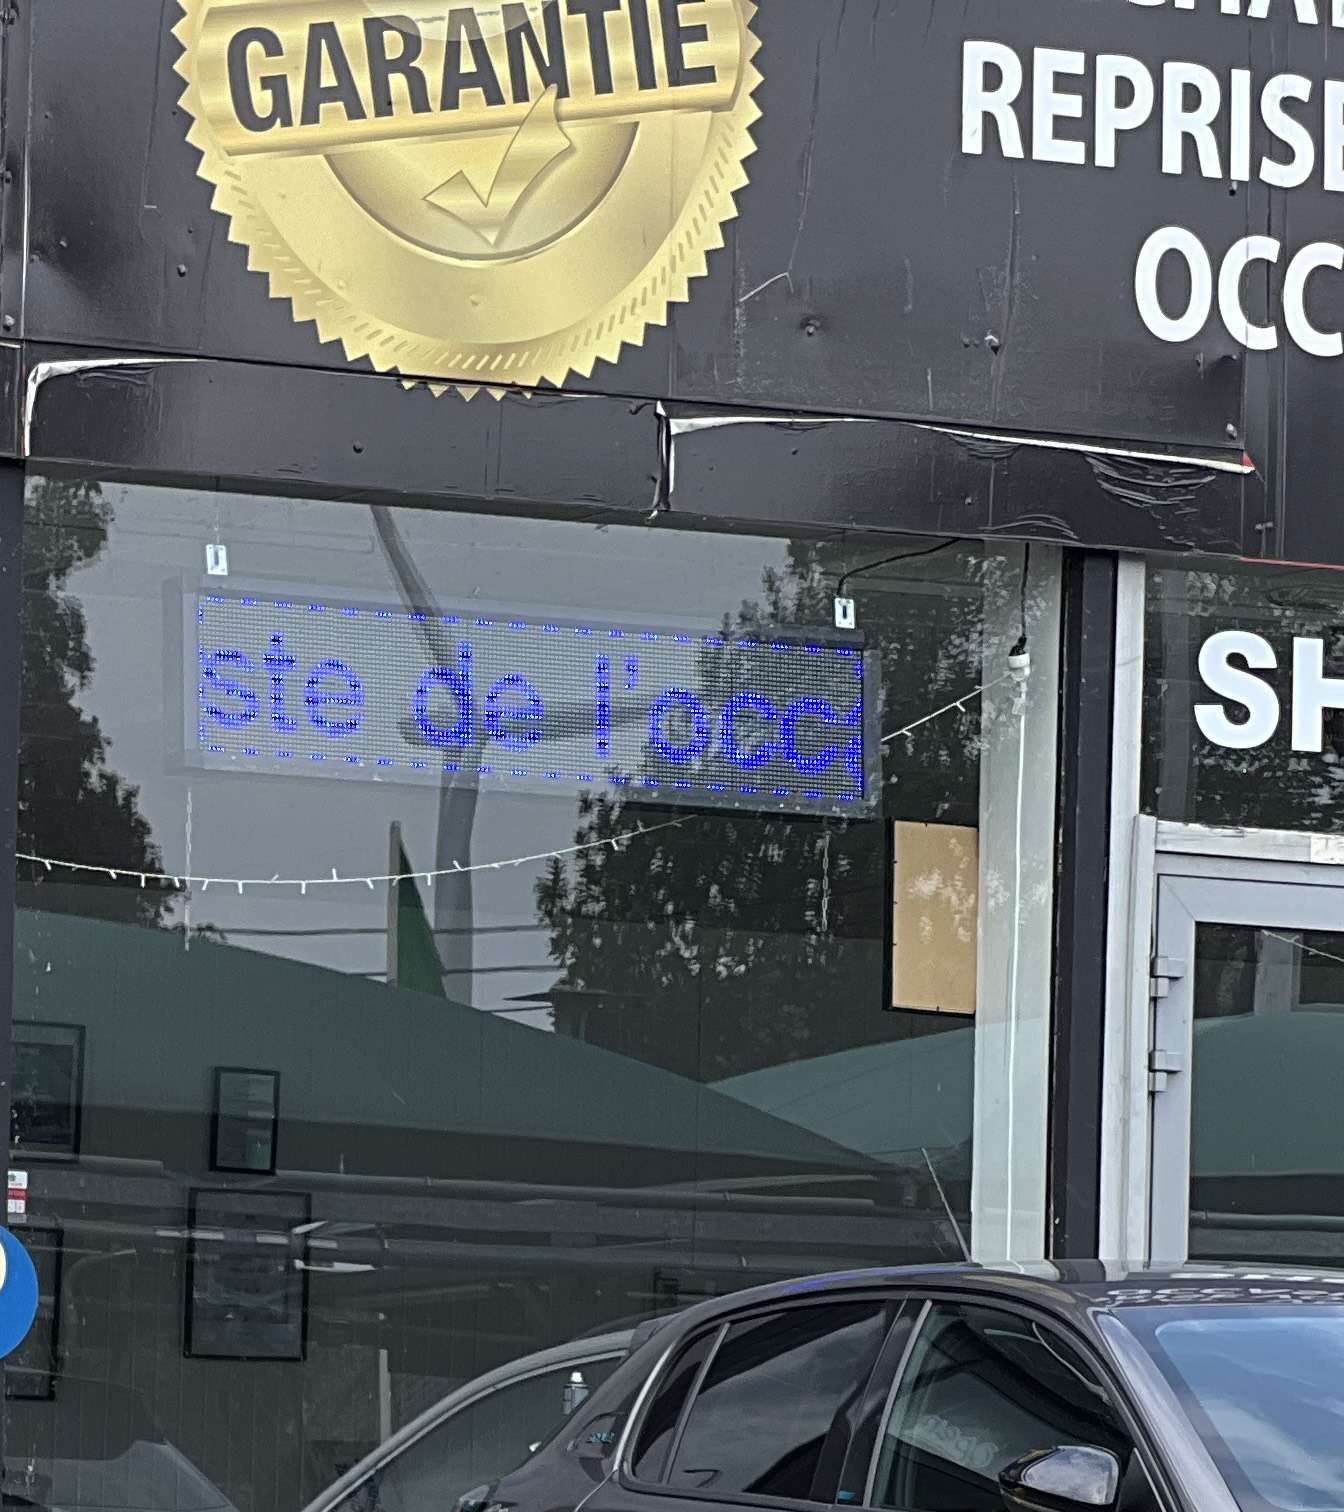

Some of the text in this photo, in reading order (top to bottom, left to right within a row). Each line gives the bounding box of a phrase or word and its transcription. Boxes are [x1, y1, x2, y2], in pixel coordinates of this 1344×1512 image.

[226, 0, 717, 133] GARANTIE
[1134, 226, 1344, 357] OCC
[200, 631, 363, 737] ste
[413, 640, 544, 750] de
[1193, 630, 1344, 753] SH
